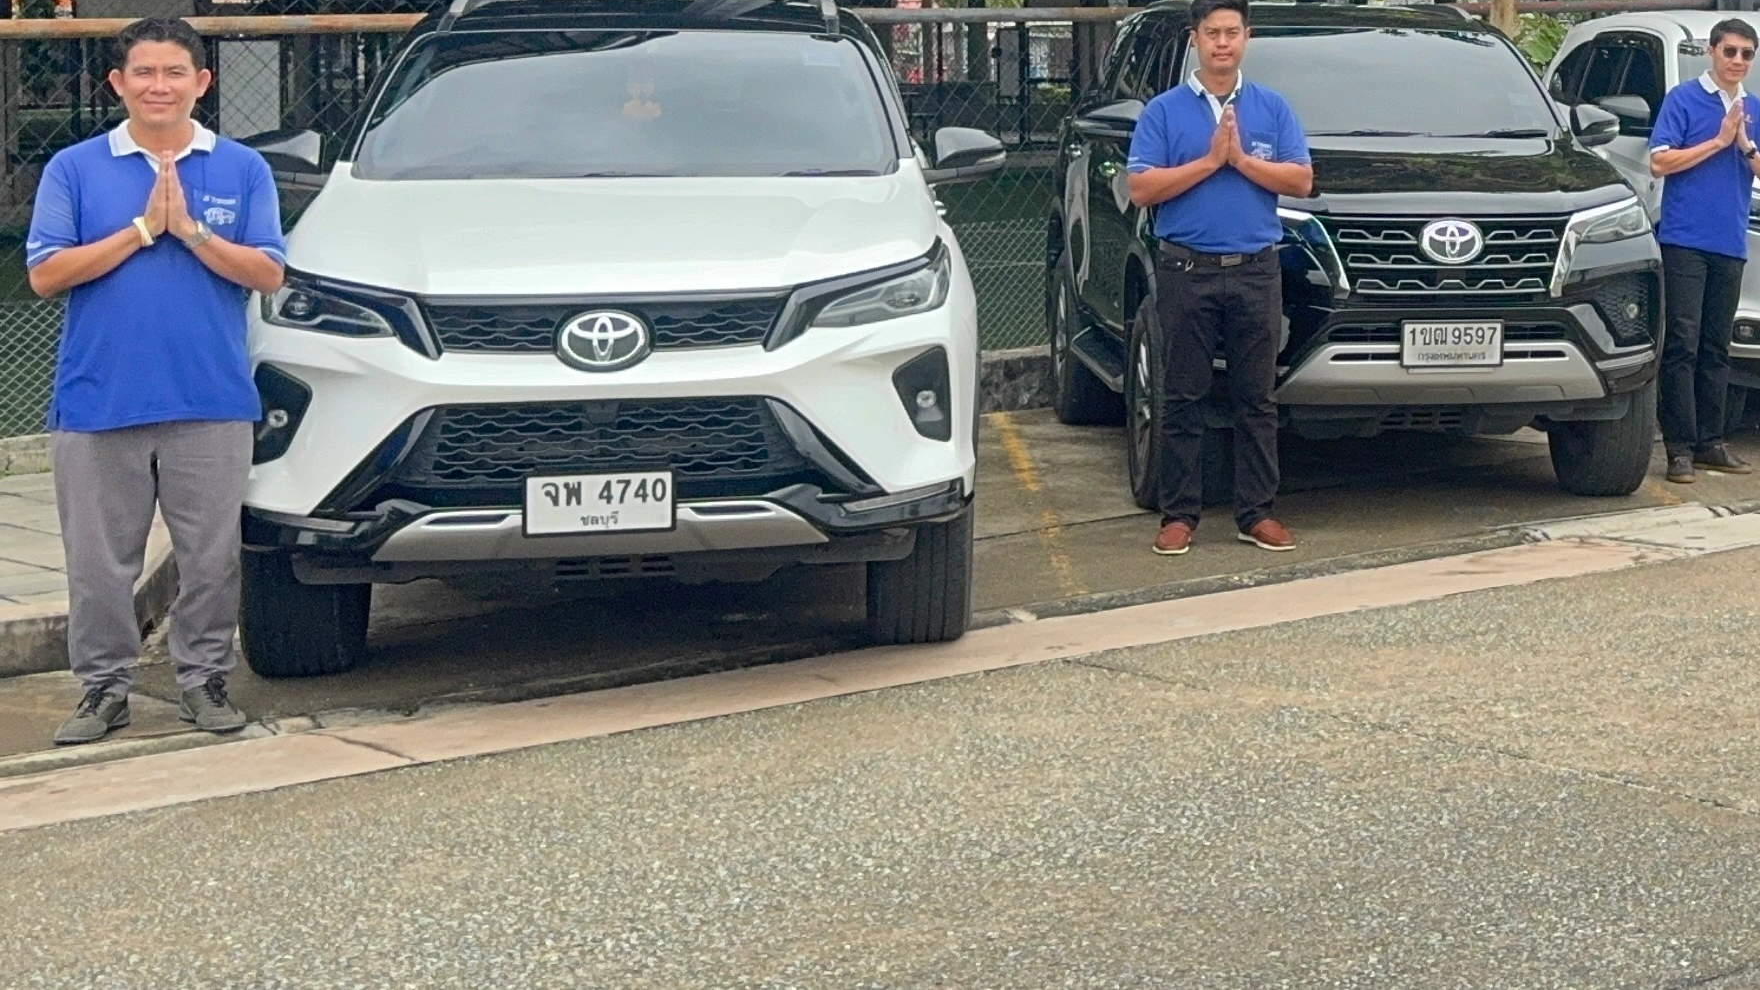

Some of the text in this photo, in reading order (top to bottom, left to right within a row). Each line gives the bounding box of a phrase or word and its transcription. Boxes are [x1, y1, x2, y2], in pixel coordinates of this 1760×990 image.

[1451, 326, 1498, 346] 9597
[541, 477, 667, 507] จพ 4740
[580, 510, 619, 529] ชลบุรี
